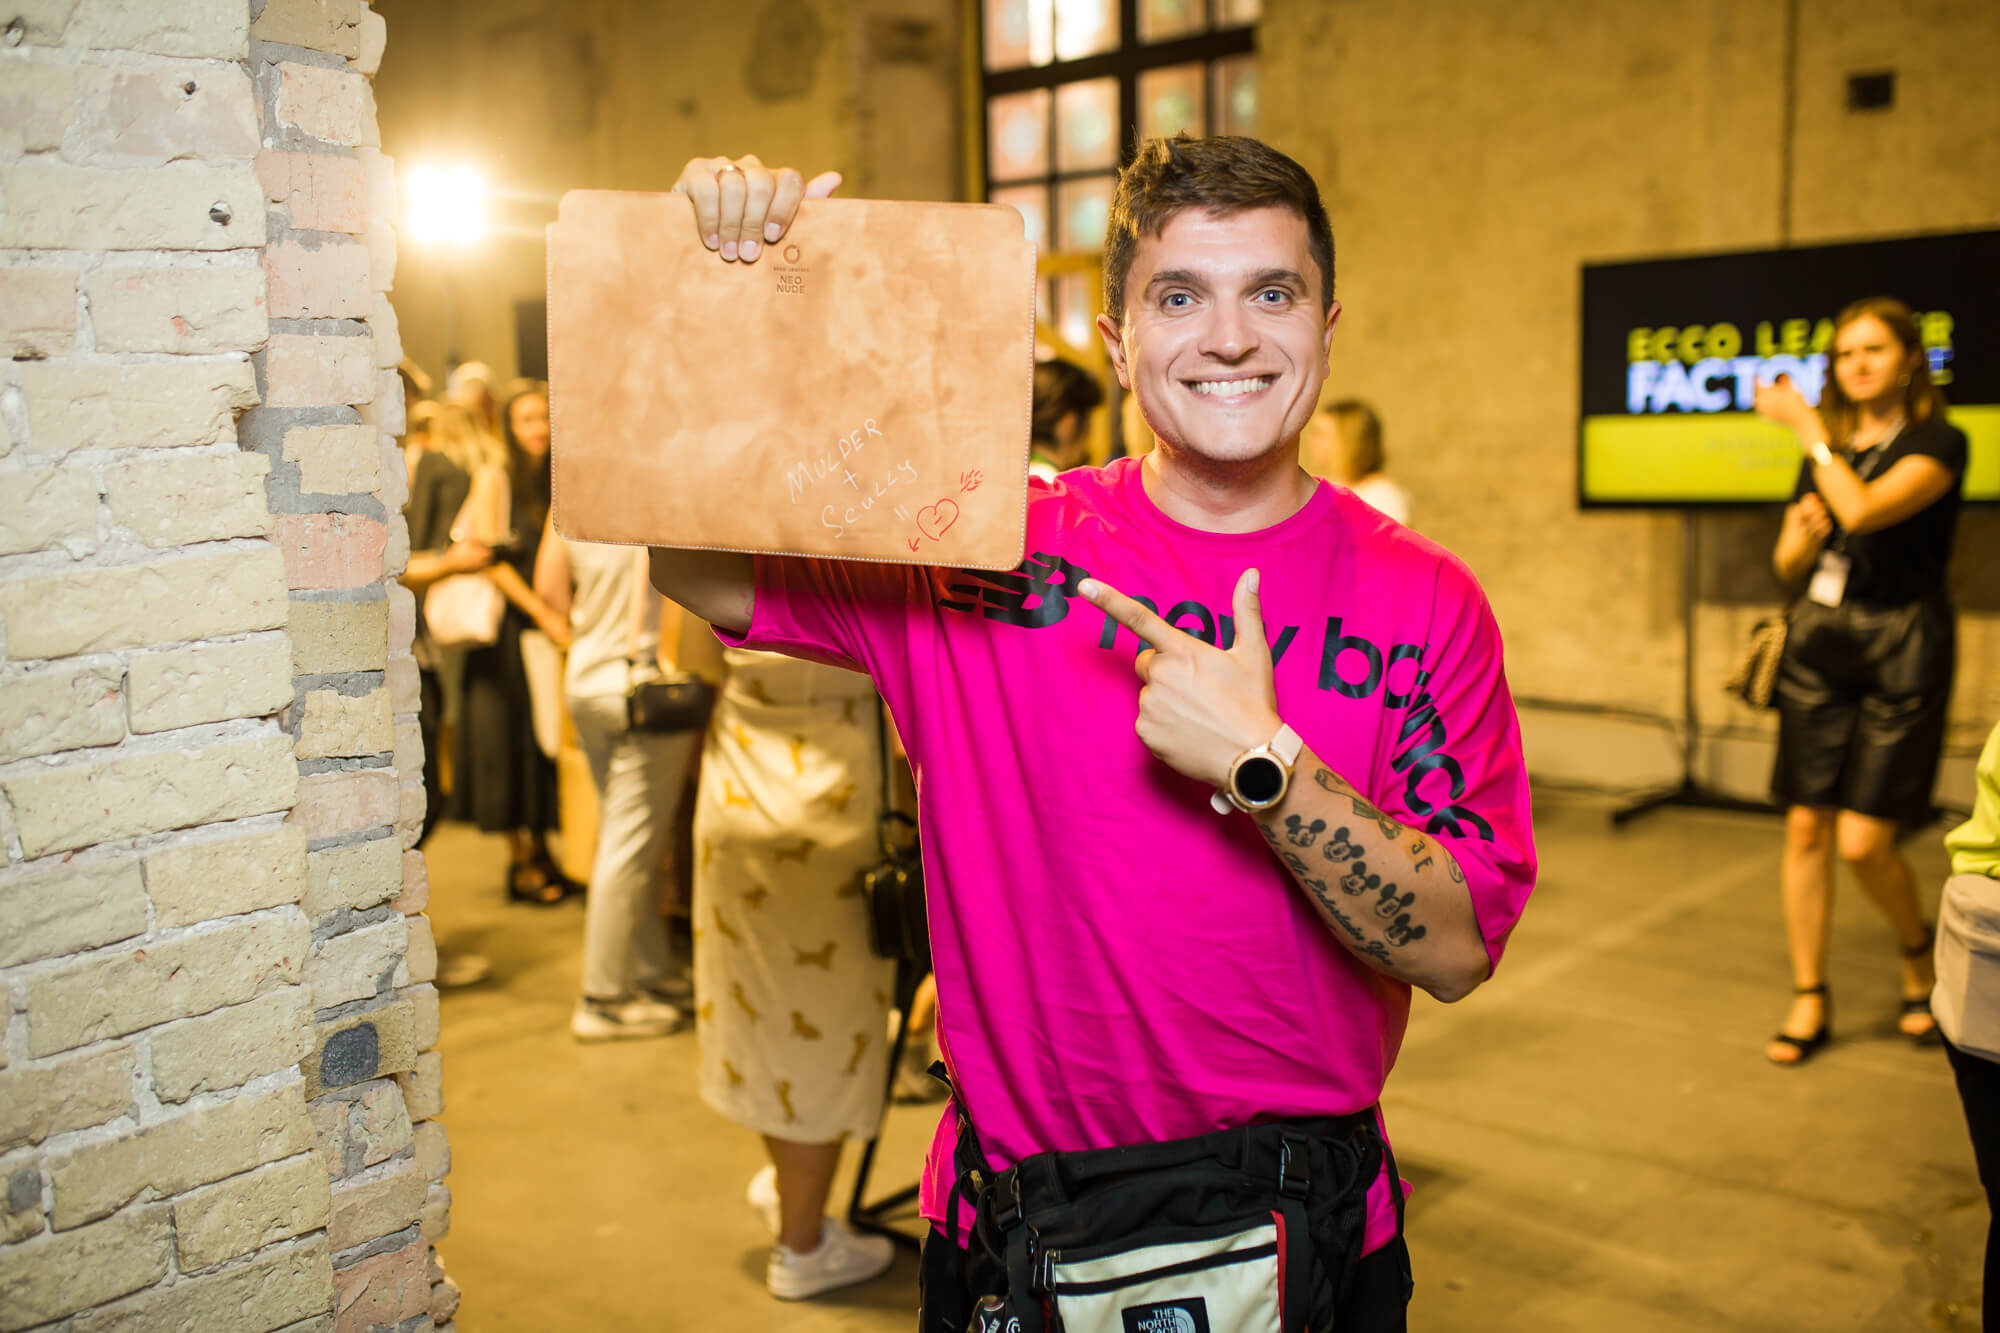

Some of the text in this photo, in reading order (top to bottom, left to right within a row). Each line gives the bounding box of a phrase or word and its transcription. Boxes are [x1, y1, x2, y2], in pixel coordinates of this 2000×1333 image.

[780, 275, 802, 285] NEO
[776, 284, 806, 294] NUDE
[1627, 322, 1743, 365] ECCO
[1152, 1307, 1175, 1319] THE
[1137, 1319, 1176, 1331] NORTH
